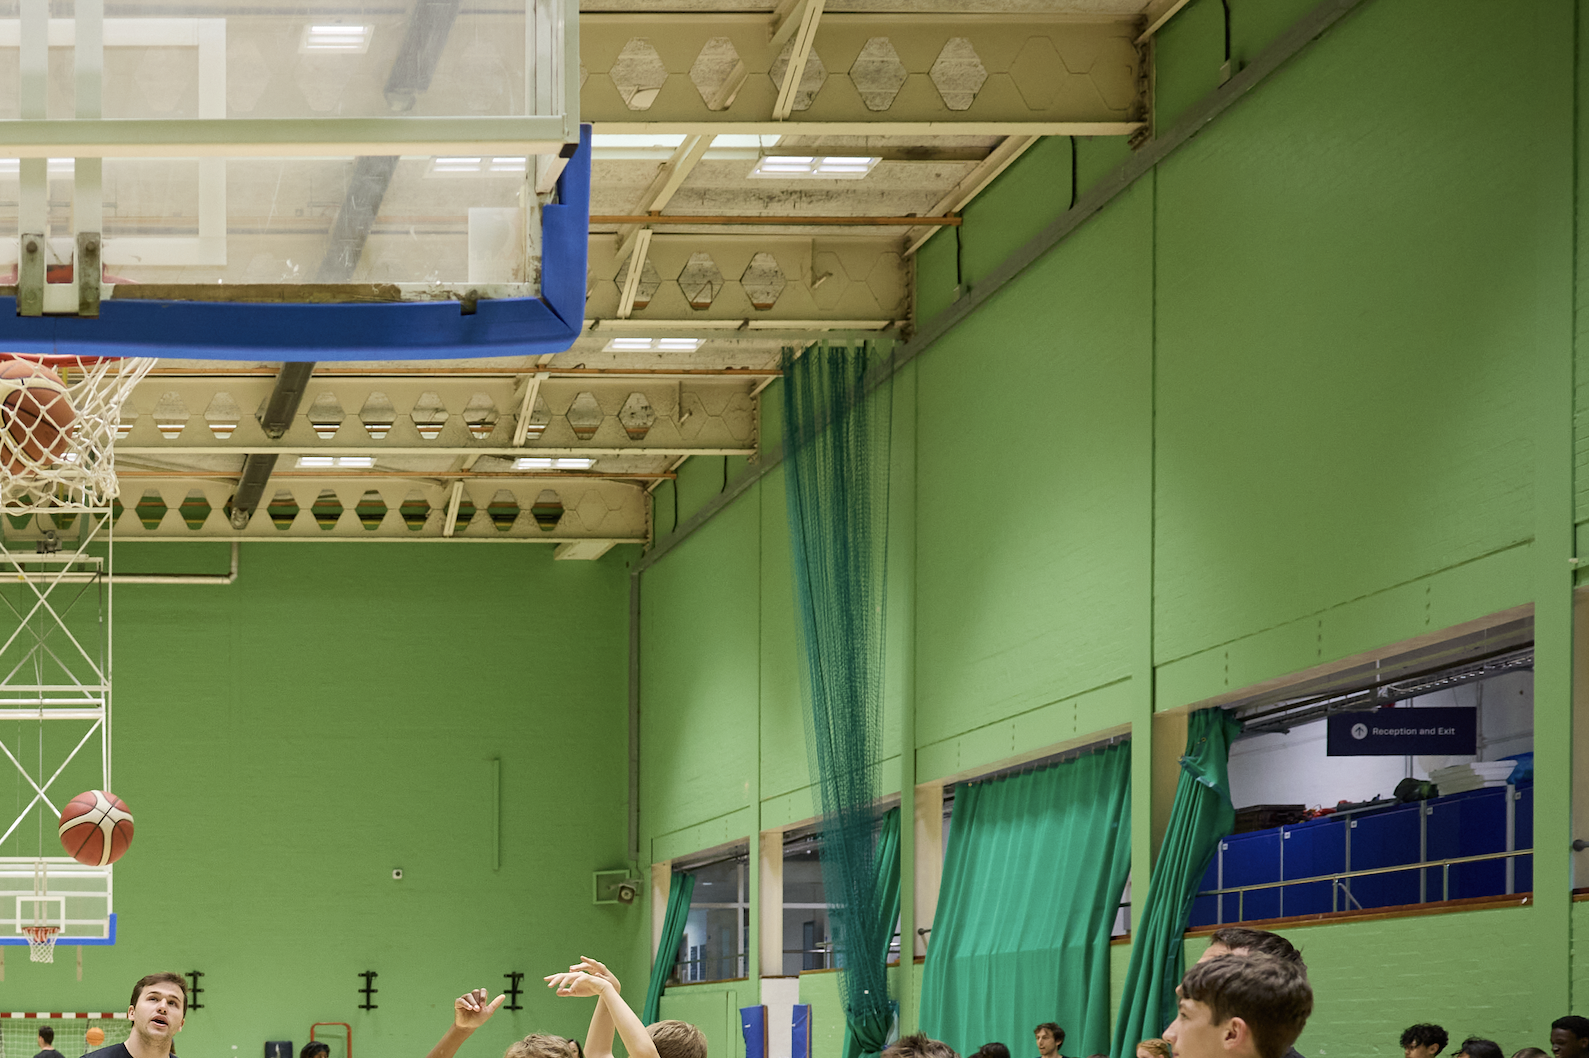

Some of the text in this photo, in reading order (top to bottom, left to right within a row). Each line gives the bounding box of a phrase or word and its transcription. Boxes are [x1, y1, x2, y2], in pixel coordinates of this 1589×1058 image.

[1372, 727, 1456, 736] Reception and Exit
